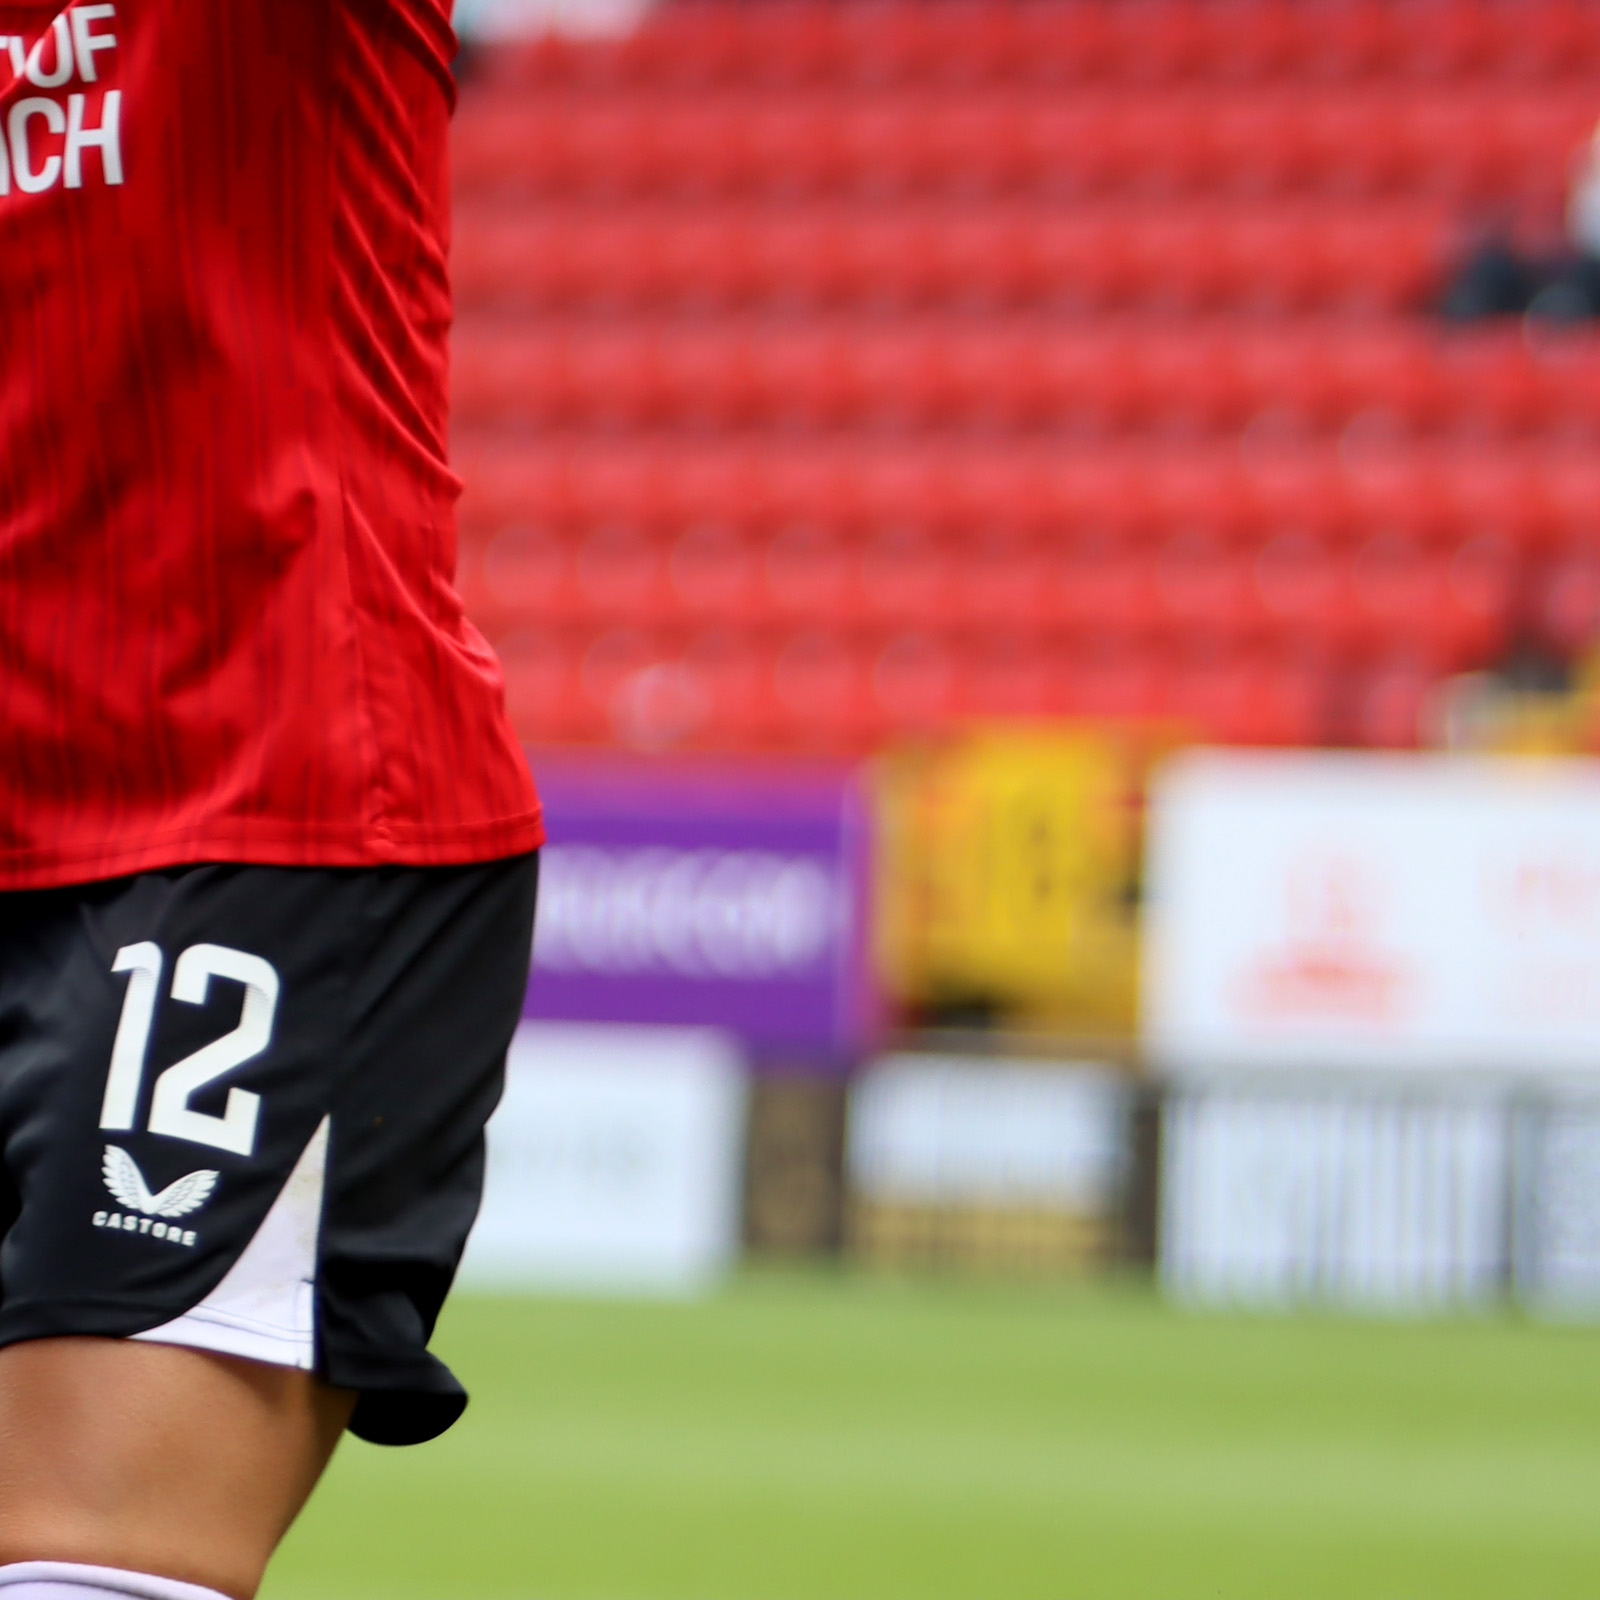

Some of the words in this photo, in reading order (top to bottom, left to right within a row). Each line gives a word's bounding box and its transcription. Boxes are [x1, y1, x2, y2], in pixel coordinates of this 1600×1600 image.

[25, 3, 117, 89] OF
[99, 941, 278, 1157] 12
[91, 1210, 197, 1247] CASTORE
